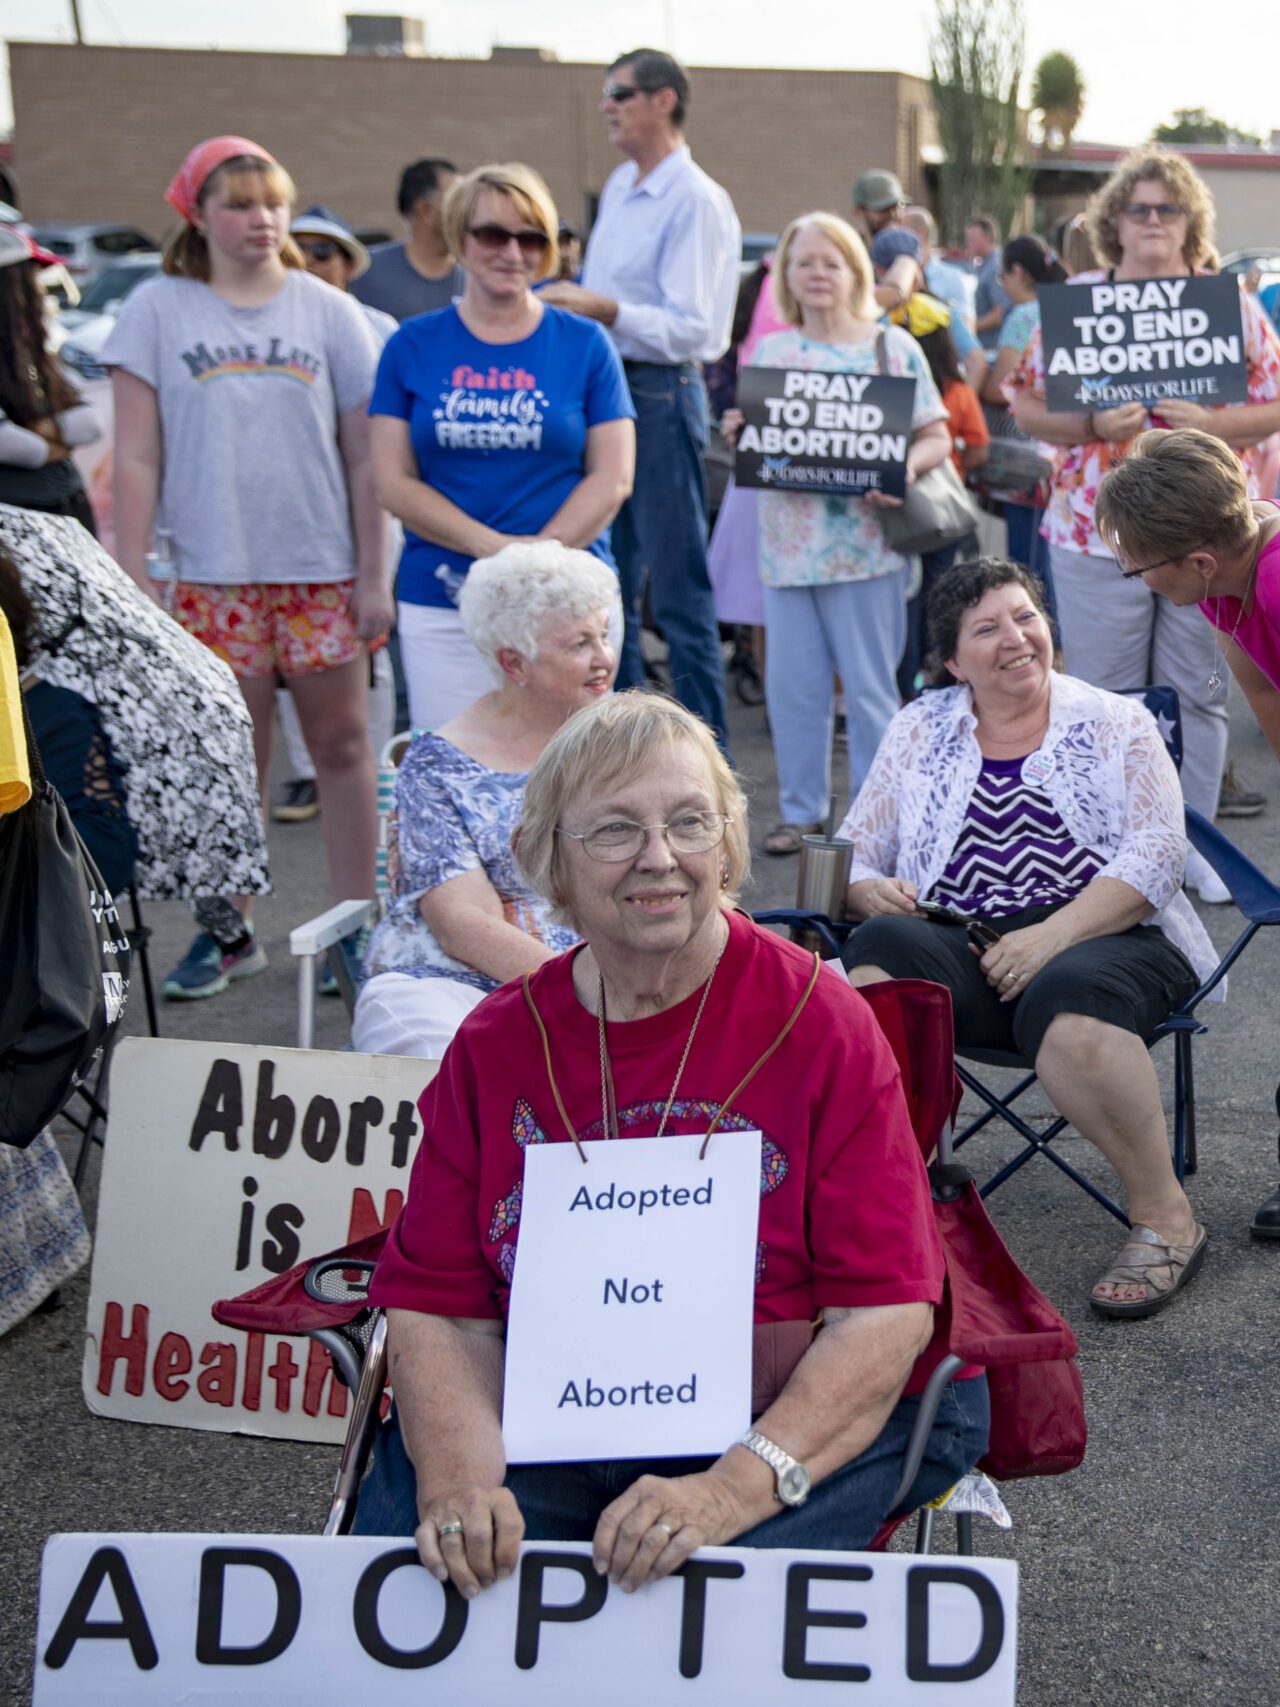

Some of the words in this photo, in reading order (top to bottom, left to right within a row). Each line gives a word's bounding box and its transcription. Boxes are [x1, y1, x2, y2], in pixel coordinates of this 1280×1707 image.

[1091, 279, 1187, 314] PRAY
[1073, 314, 1126, 345] TO
[1133, 308, 1209, 341] END
[1048, 335, 1241, 376] ABORTION
[784, 371, 871, 402] PRAY
[764, 397, 810, 427] TO
[815, 401, 884, 431] END
[435, 420, 542, 450] FREEDOM
[737, 424, 906, 463] ABORTION
[188, 1058, 419, 1169] Abort
[569, 1177, 713, 1216] Adopted
[235, 1175, 305, 1275] is
[603, 1277, 664, 1305] Not
[97, 1301, 348, 1418] Health
[557, 1373, 697, 1409] Aborted
[44, 1545, 1005, 1683] ADOPTED
